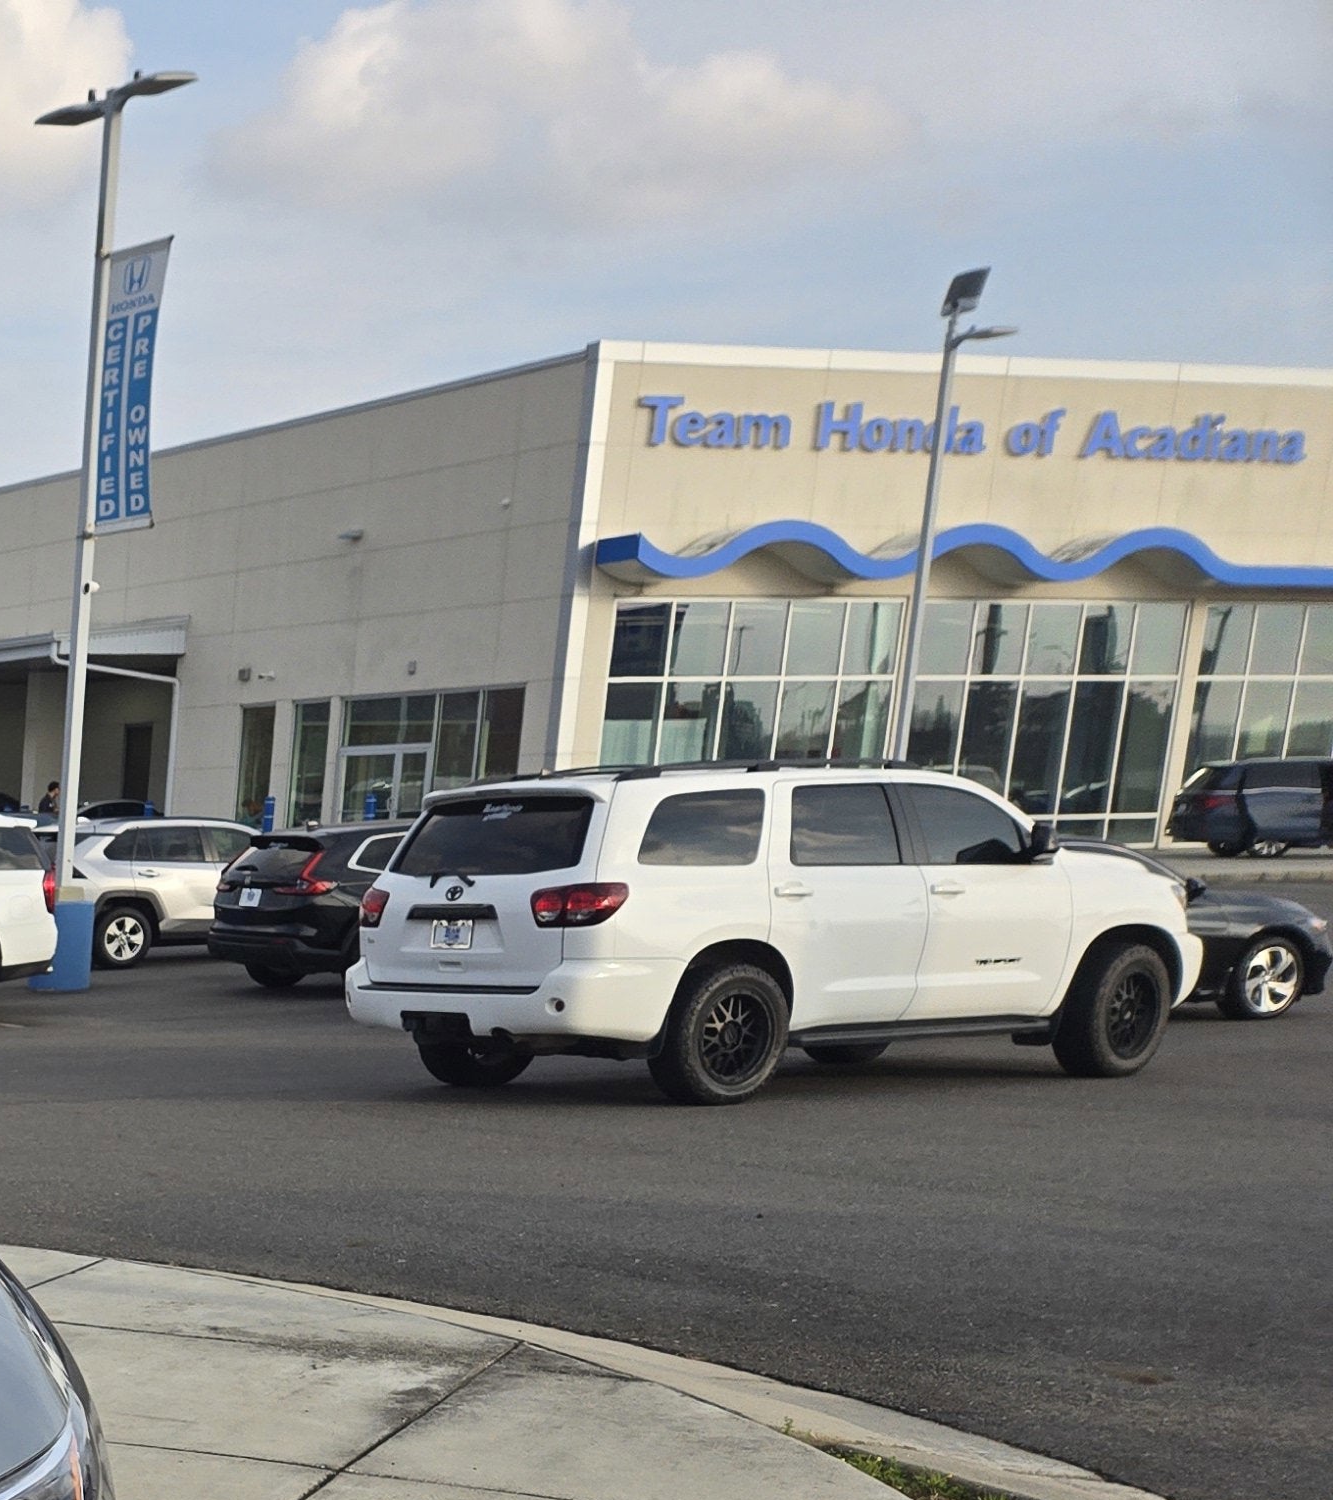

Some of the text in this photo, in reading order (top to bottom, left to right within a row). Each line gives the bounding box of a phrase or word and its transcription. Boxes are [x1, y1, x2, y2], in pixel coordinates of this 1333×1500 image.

[99, 322, 125, 517] CERTIFIED
[126, 315, 152, 512] PRE OWNED
[637, 395, 792, 447] Team
[1006, 407, 1067, 457] of
[1079, 410, 1306, 464] Acadiana
